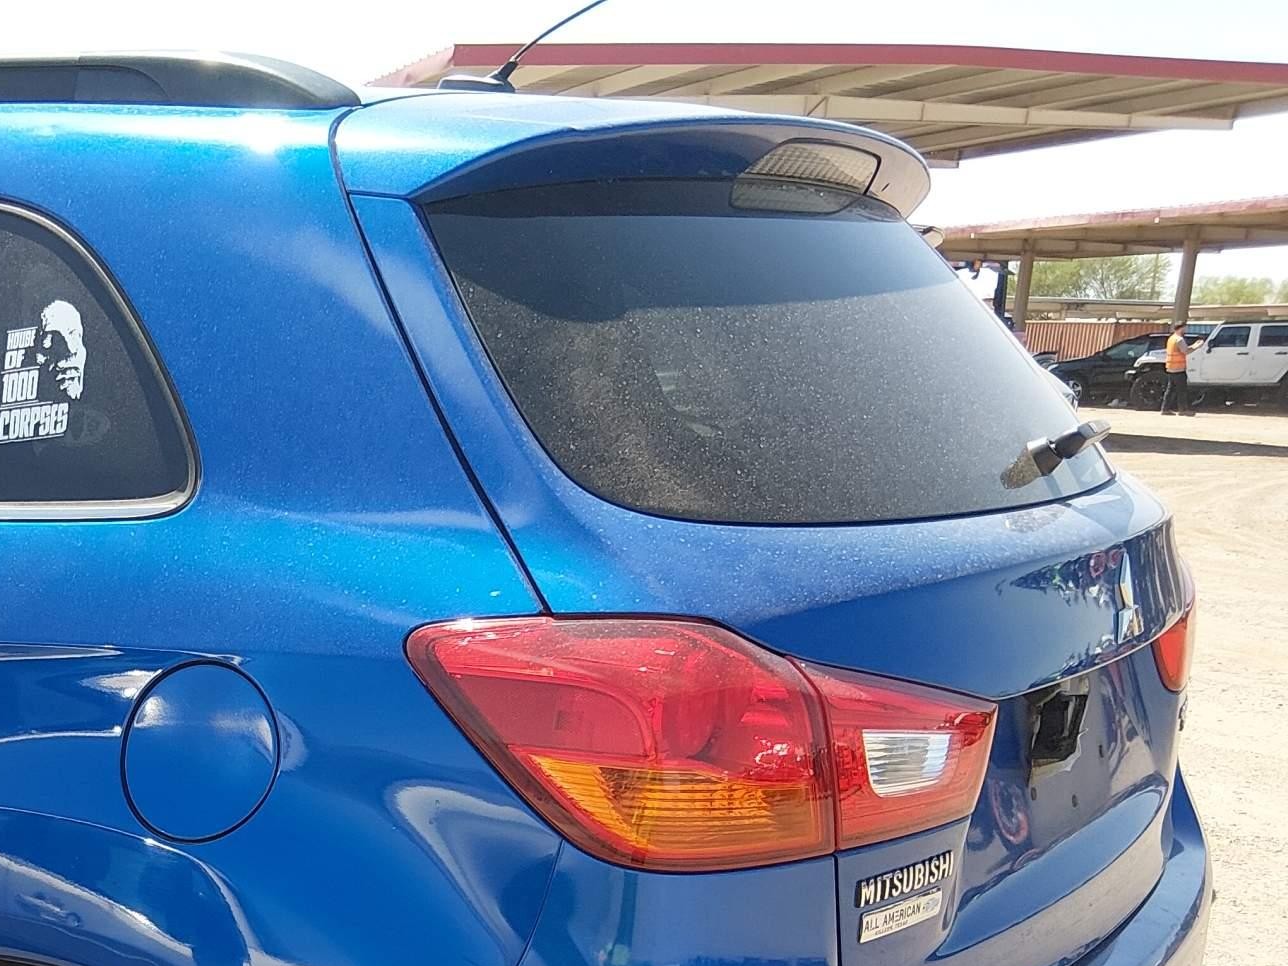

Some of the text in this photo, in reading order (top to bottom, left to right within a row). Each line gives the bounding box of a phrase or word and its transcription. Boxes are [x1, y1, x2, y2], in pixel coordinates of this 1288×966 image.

[4, 349, 26, 369] OF
[2, 370, 39, 403] 1000
[859, 851, 954, 908] MITSUBISHI
[864, 902, 921, 932] ALL AMERICAN
